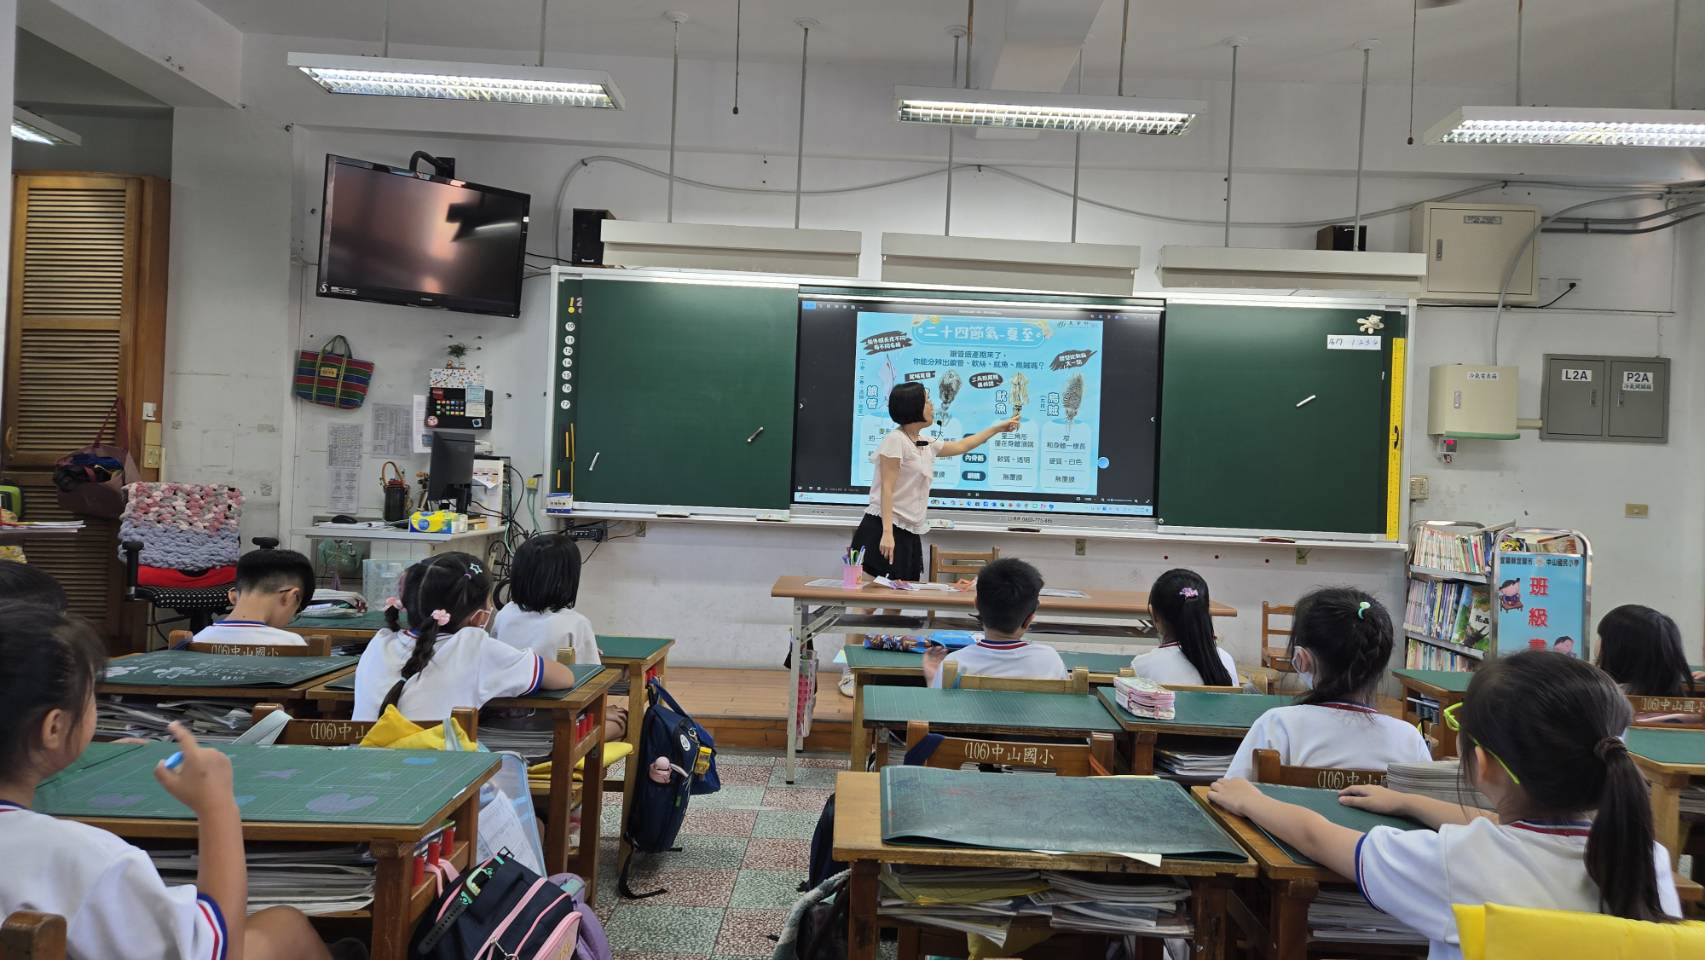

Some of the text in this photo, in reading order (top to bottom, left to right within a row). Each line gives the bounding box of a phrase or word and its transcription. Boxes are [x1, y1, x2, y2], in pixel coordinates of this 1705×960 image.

[1565, 370, 1588, 381] L2A
[1627, 372, 1649, 383] P2A
[964, 741, 1055, 765] (106)中山國小
